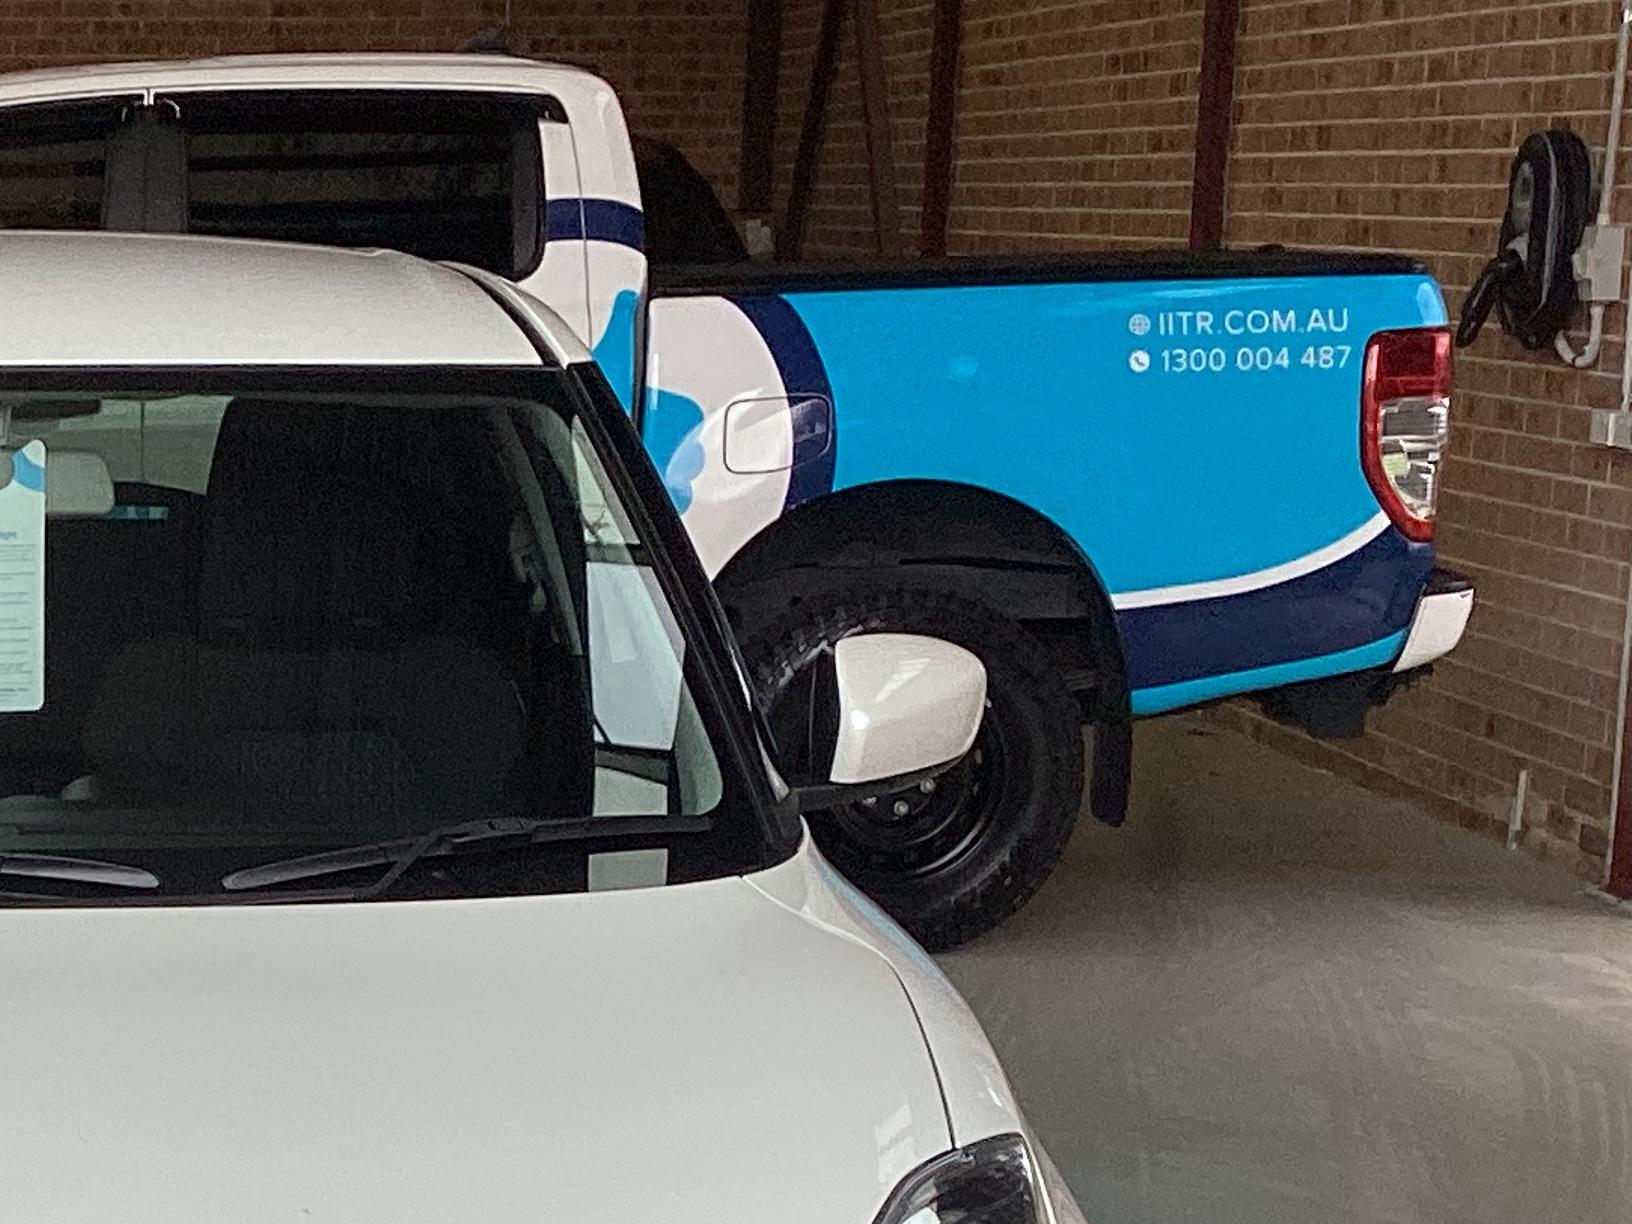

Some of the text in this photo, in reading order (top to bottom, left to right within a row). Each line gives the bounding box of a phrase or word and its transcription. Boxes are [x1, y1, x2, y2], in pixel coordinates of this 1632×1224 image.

[1158, 308, 1349, 336] IITR.COM.AU
[1160, 346, 1352, 373] 1300 004 487
